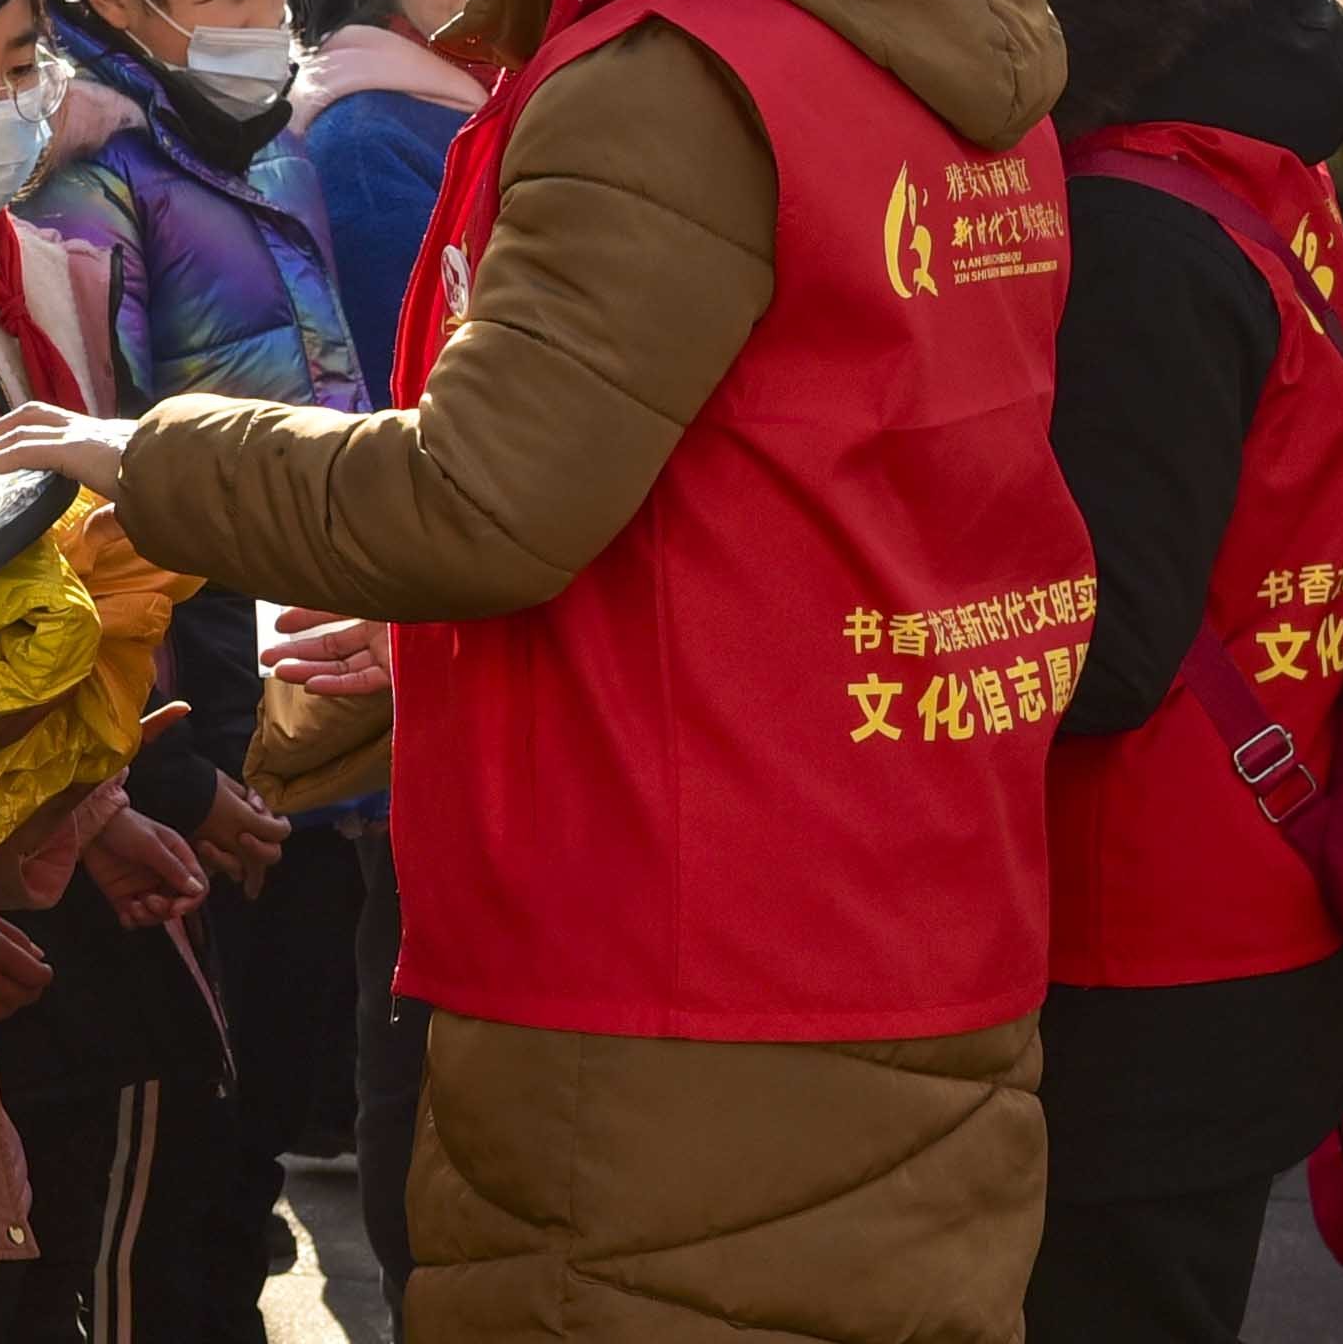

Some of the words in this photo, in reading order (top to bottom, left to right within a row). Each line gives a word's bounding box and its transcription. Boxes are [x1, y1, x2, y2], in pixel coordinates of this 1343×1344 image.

[843, 574, 1097, 657] 书香龙溪新时代文明实
